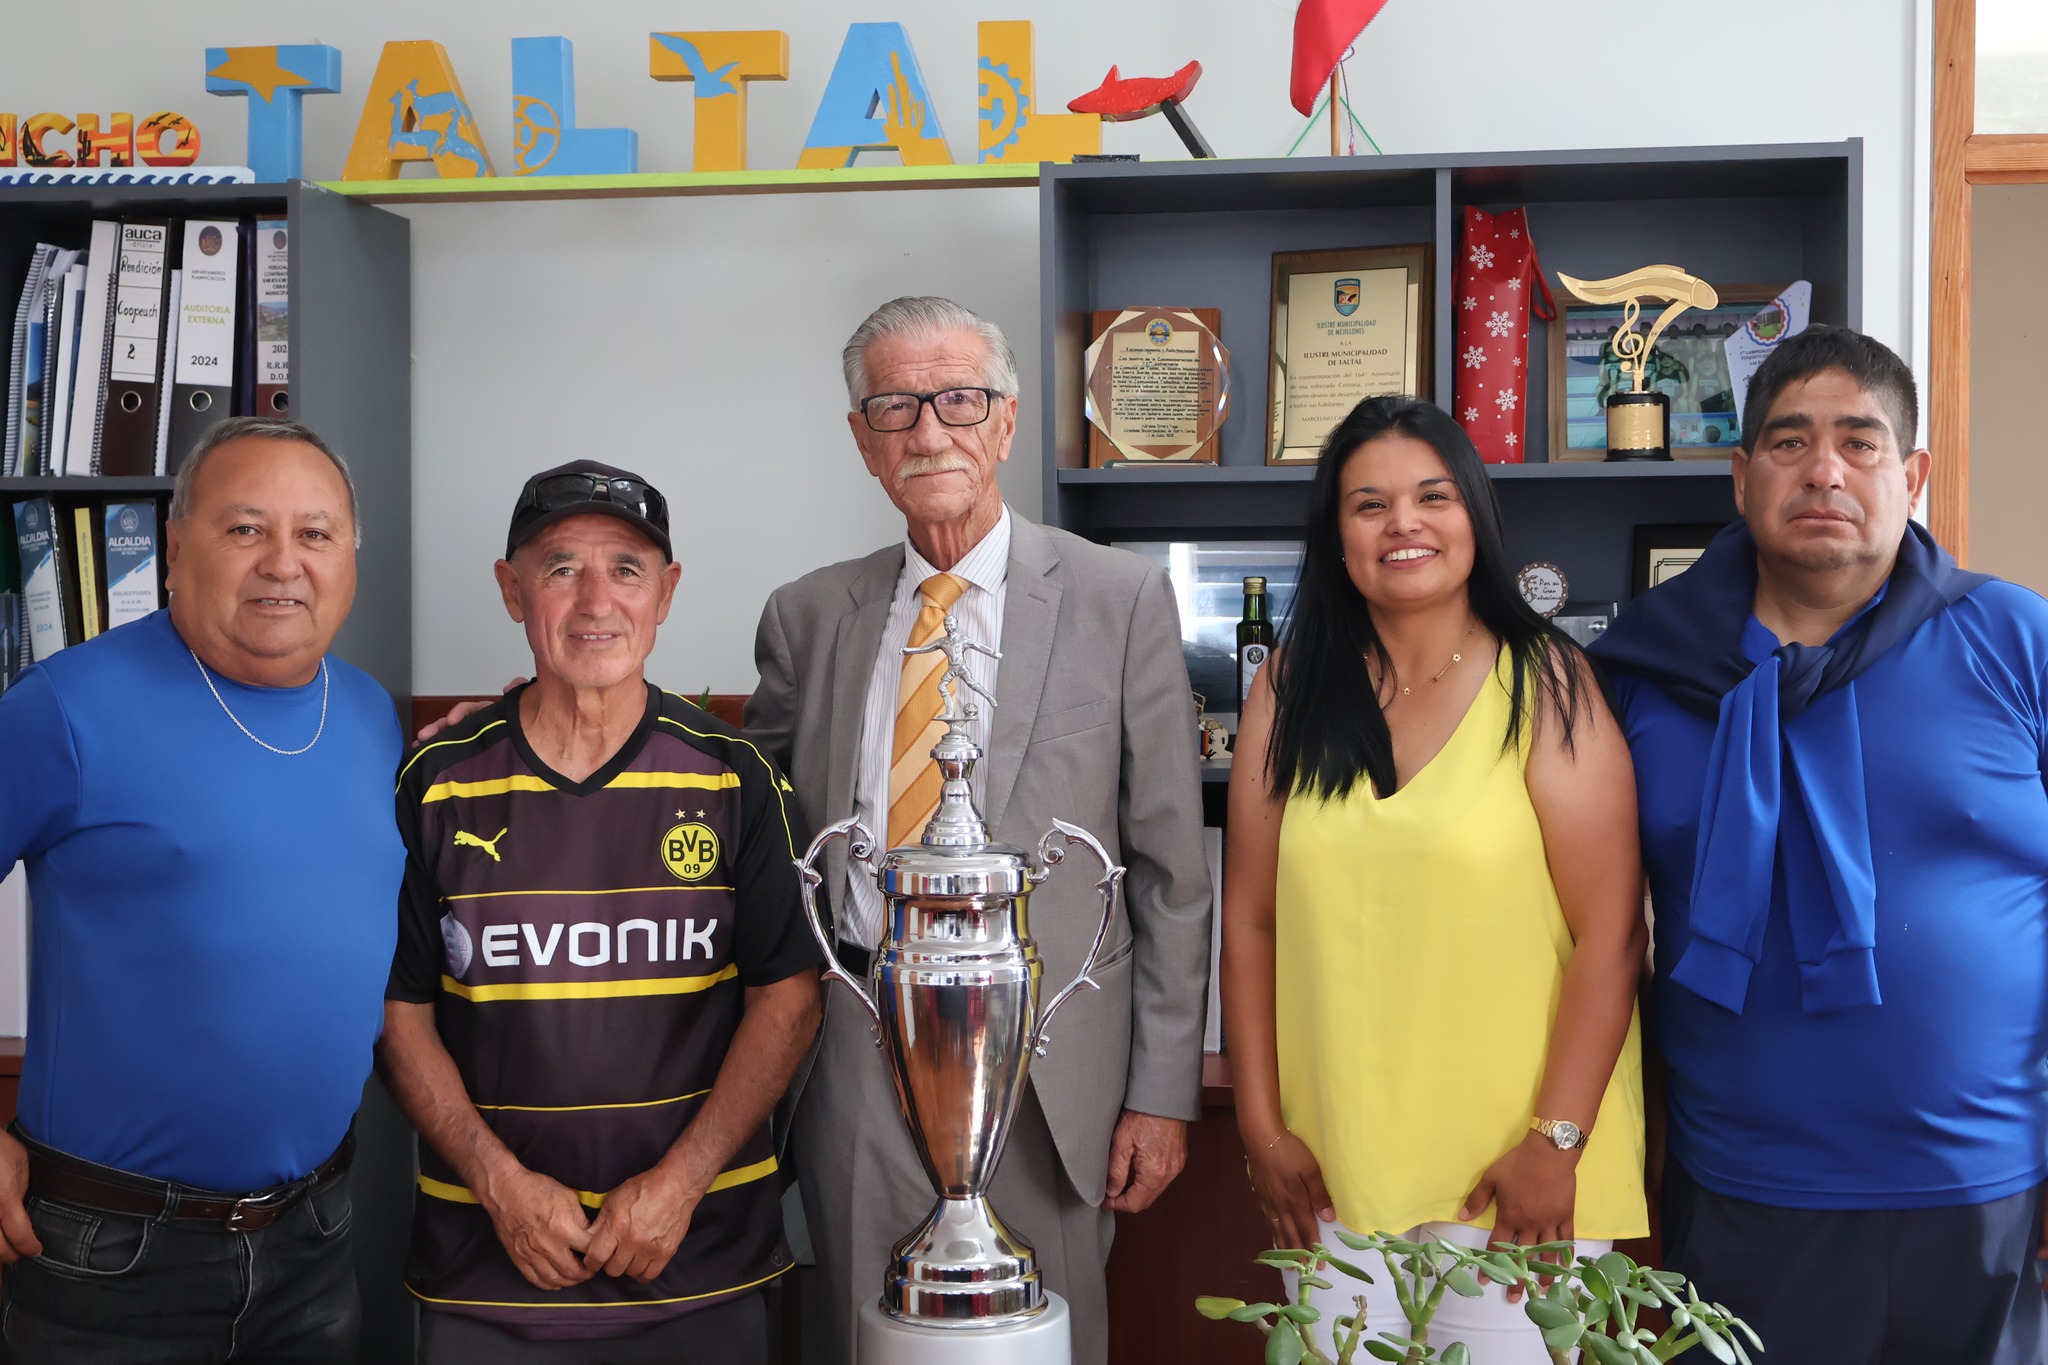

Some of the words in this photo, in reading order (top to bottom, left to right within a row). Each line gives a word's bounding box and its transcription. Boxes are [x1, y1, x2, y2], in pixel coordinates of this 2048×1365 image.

[125, 228, 162, 240] auca
[120, 255, 162, 274] Rendición
[117, 300, 158, 323] Coopeuch
[183, 304, 231, 314] AUDITORIA
[187, 315, 226, 325] EXTERNA
[1317, 321, 1336, 329] ILUSTRE
[1337, 319, 1377, 328] MUNICIPALIDAD
[1335, 328, 1365, 336] MEJILLONES
[126, 343, 136, 360] 2
[272, 344, 288, 353] 202
[1303, 350, 1330, 359] ILUSTRE
[1331, 348, 1388, 357] MUNICIPALIDAD
[190, 355, 219, 367] 2024
[108, 536, 152, 547] ALCALDIA
[668, 830, 715, 862] BVB
[683, 863, 700, 874] 09
[481, 918, 718, 967] EVONIK
